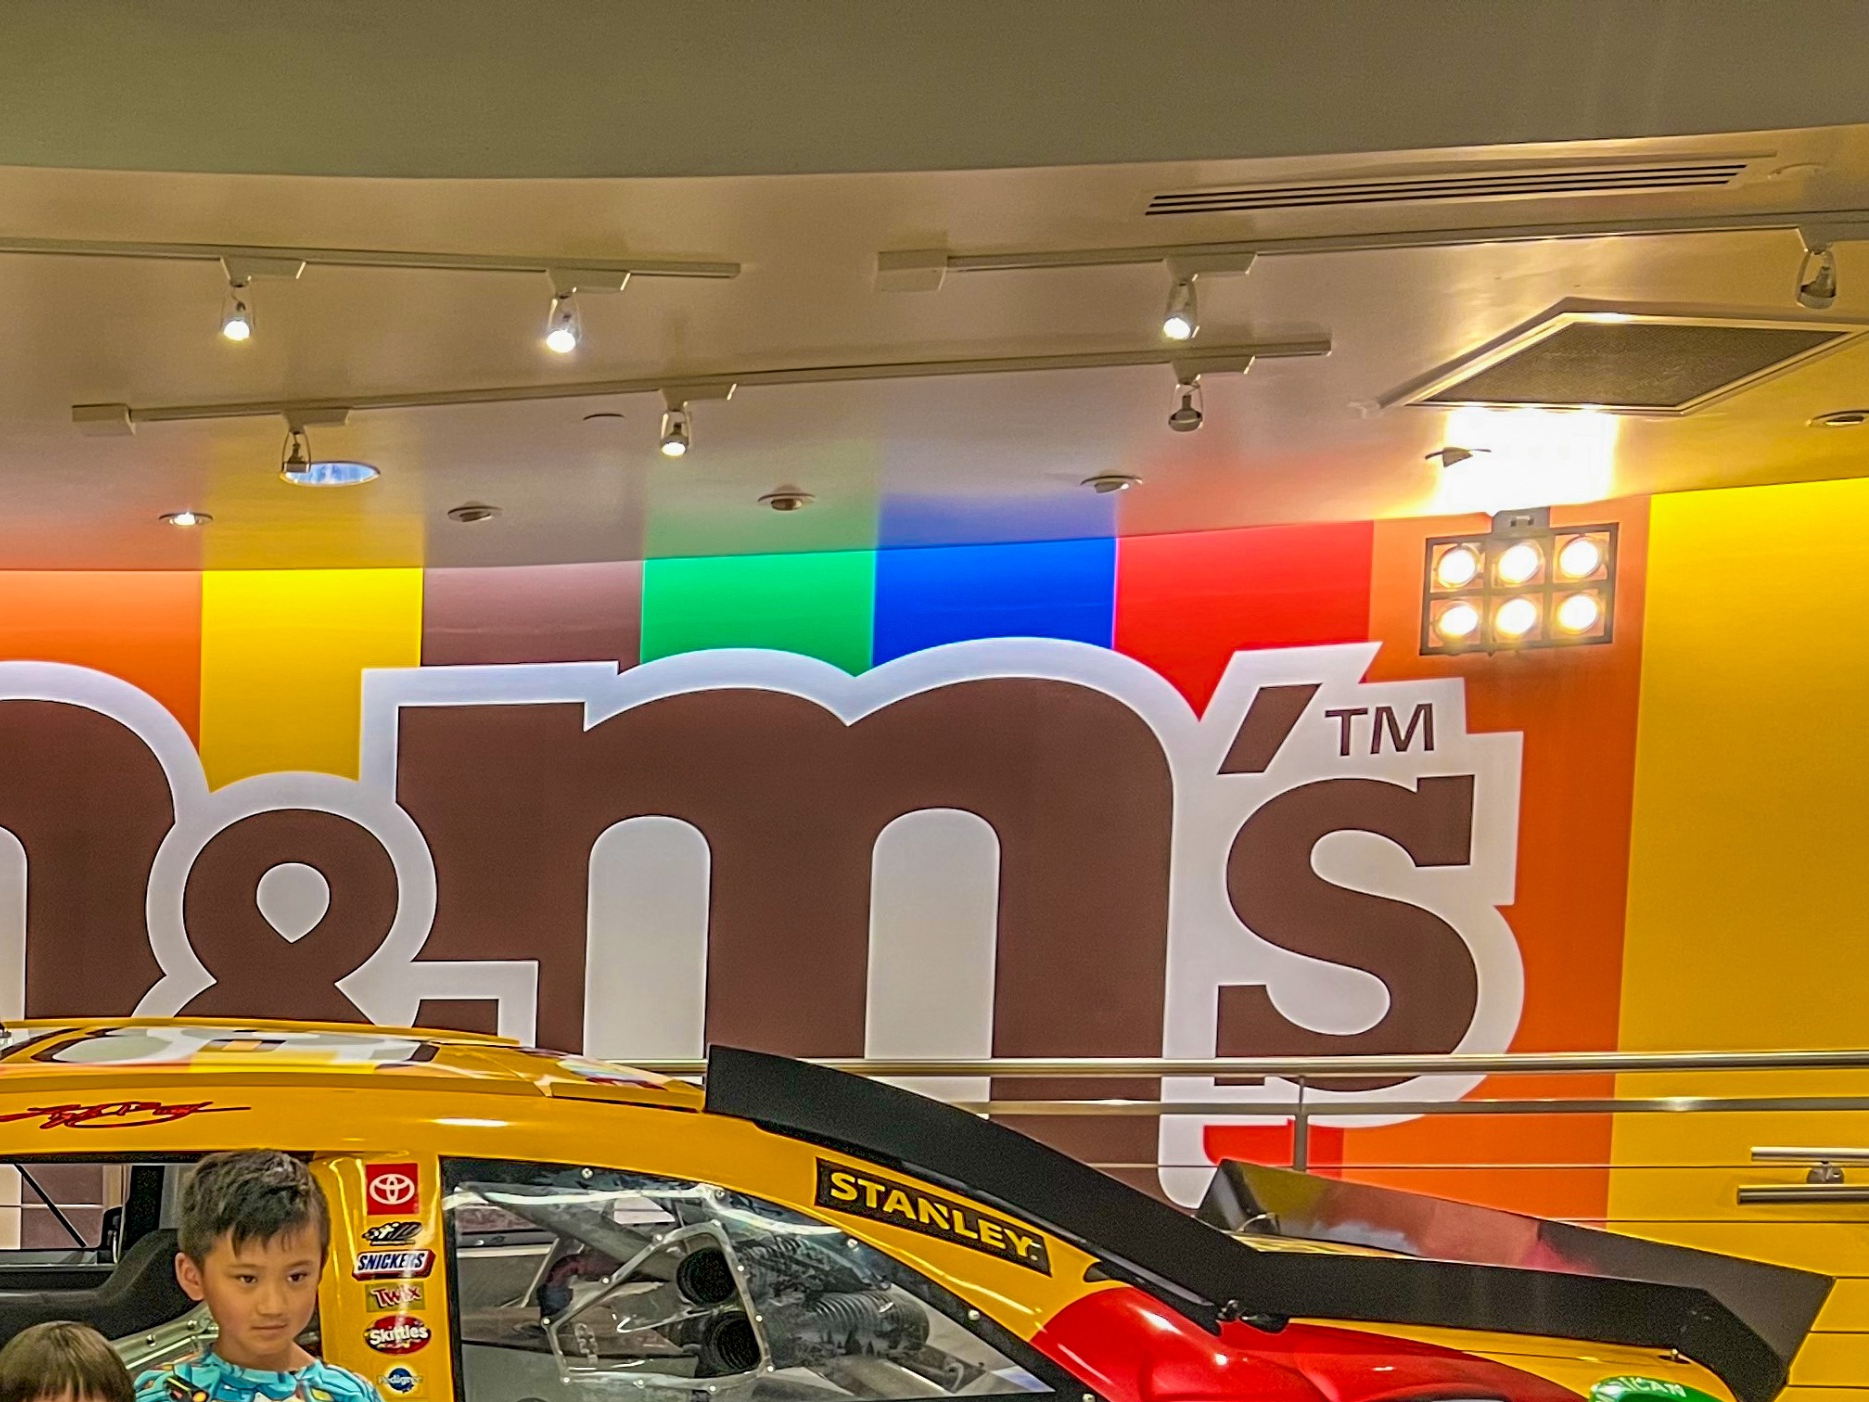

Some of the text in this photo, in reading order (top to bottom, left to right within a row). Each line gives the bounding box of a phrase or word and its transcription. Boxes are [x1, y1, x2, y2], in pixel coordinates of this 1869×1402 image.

[831, 1172, 1038, 1257] STANLEY
[358, 1253, 425, 1270] SNICKERS
[369, 1324, 428, 1346] Skittles
